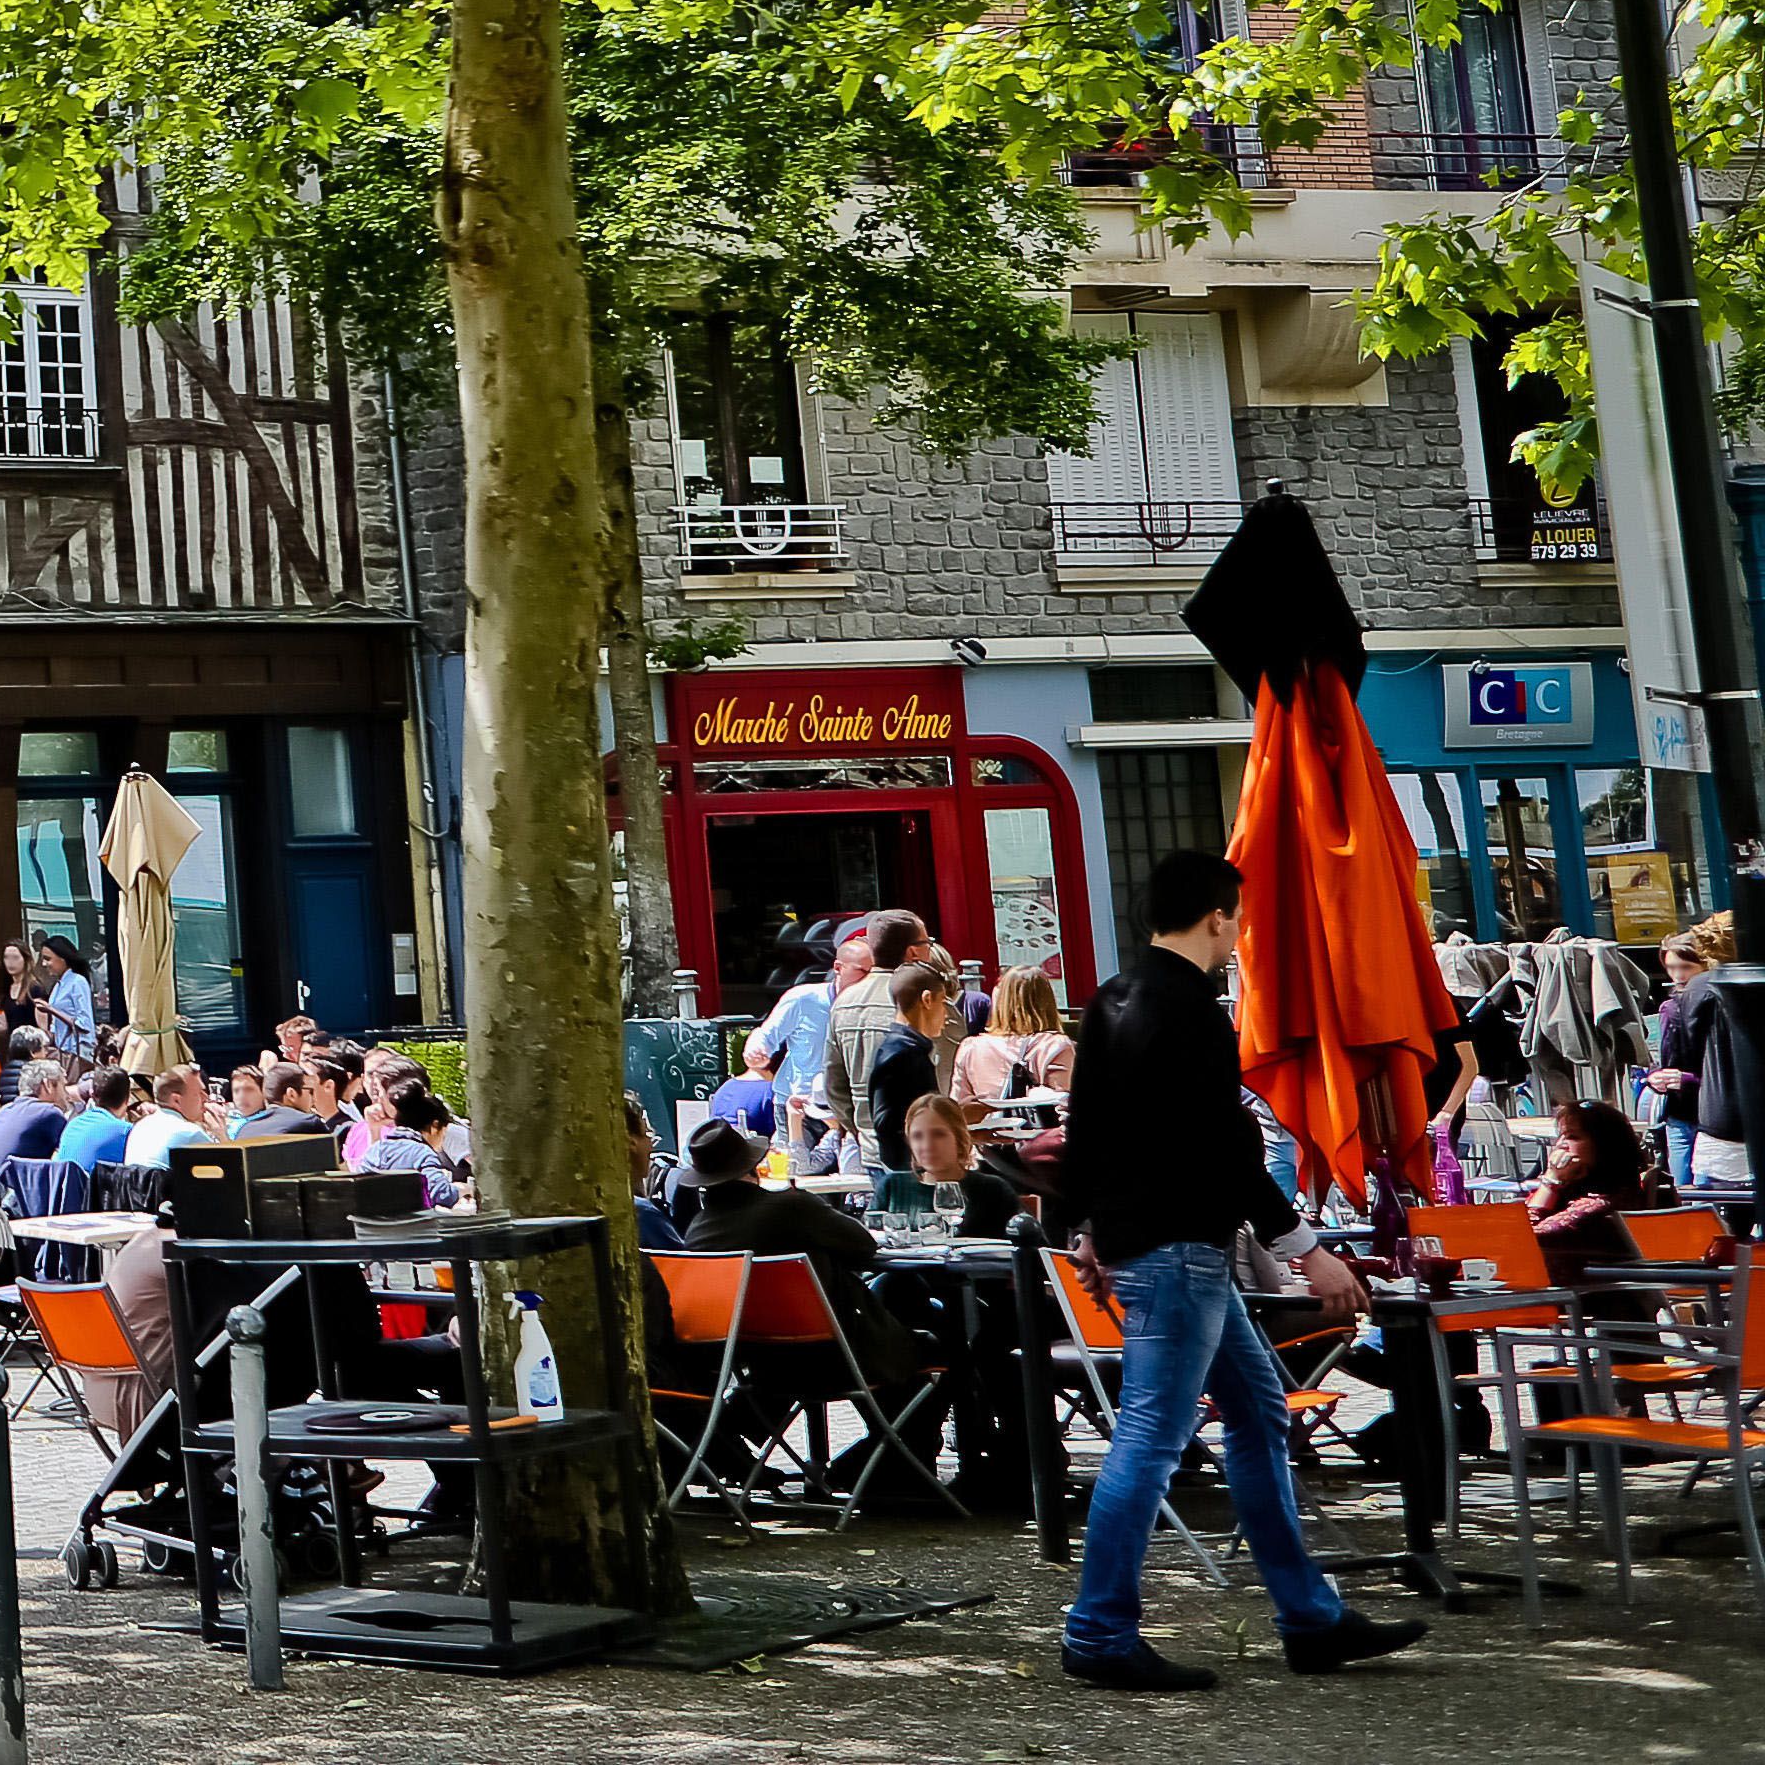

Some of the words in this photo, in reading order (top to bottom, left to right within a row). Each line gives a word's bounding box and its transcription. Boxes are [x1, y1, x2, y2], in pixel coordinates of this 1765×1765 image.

[1533, 508, 1589, 519] LELIEVRE
[1531, 530, 1542, 544] A
[1546, 528, 1596, 544] LOUER
[1539, 545, 1557, 559] 79
[1560, 544, 1577, 559] 29
[1580, 543, 1597, 558] 39
[1479, 679, 1561, 715] CIC
[694, 696, 795, 746] Marché
[799, 694, 873, 743] Sainte
[882, 694, 952, 741] Anne
[1496, 728, 1544, 742] Bretagne
